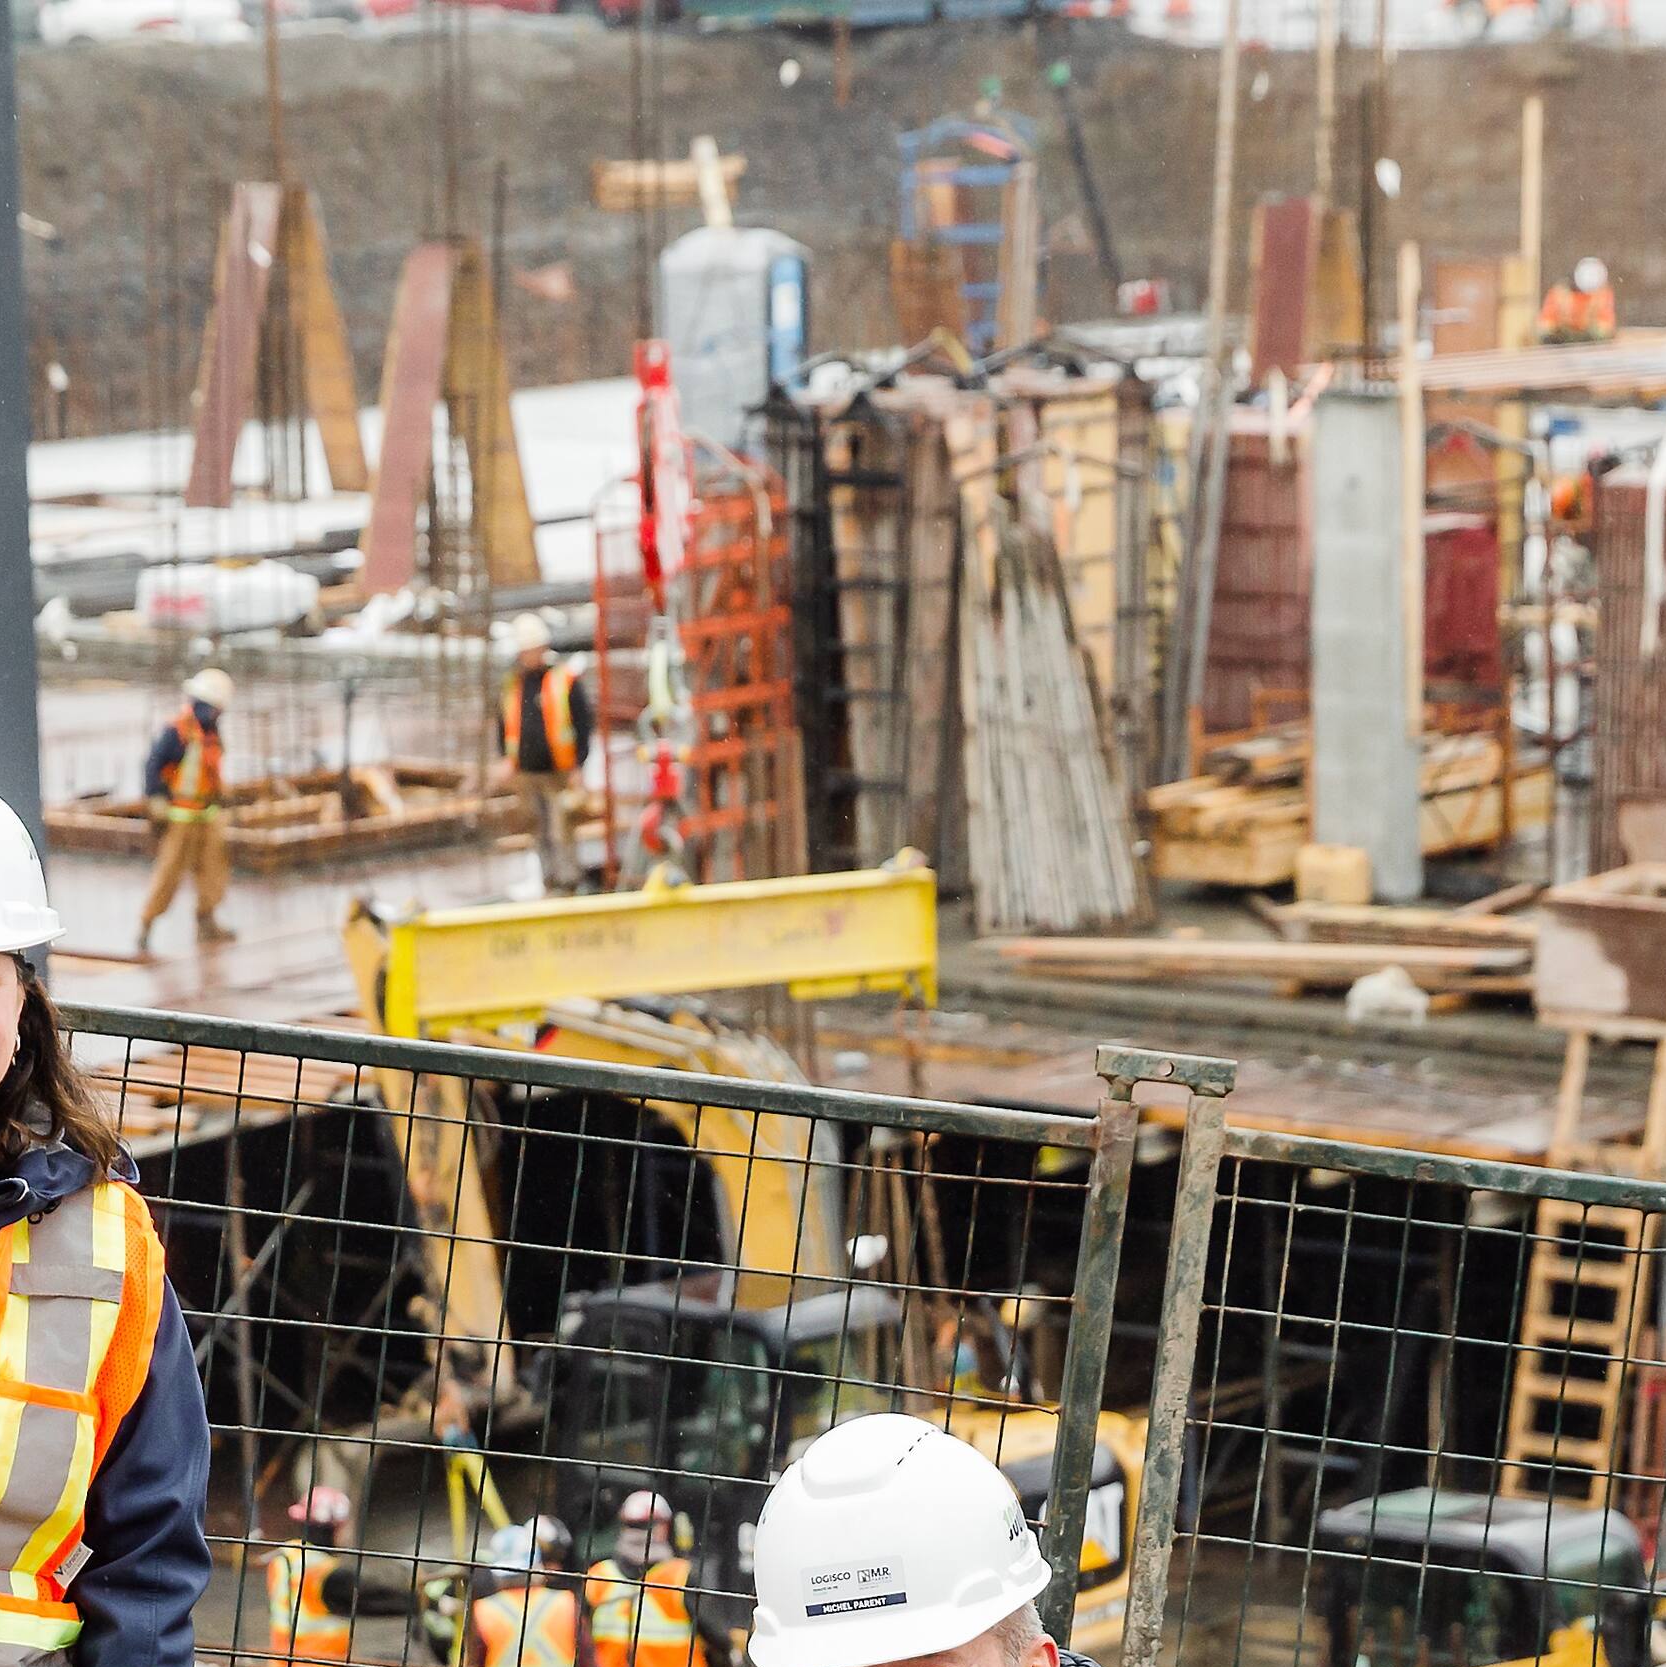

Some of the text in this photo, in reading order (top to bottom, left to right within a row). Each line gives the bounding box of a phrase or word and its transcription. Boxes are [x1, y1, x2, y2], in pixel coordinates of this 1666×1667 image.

[811, 1572, 851, 1584] LOGISCO
[822, 1598, 887, 1613] MICHEL PARENT
